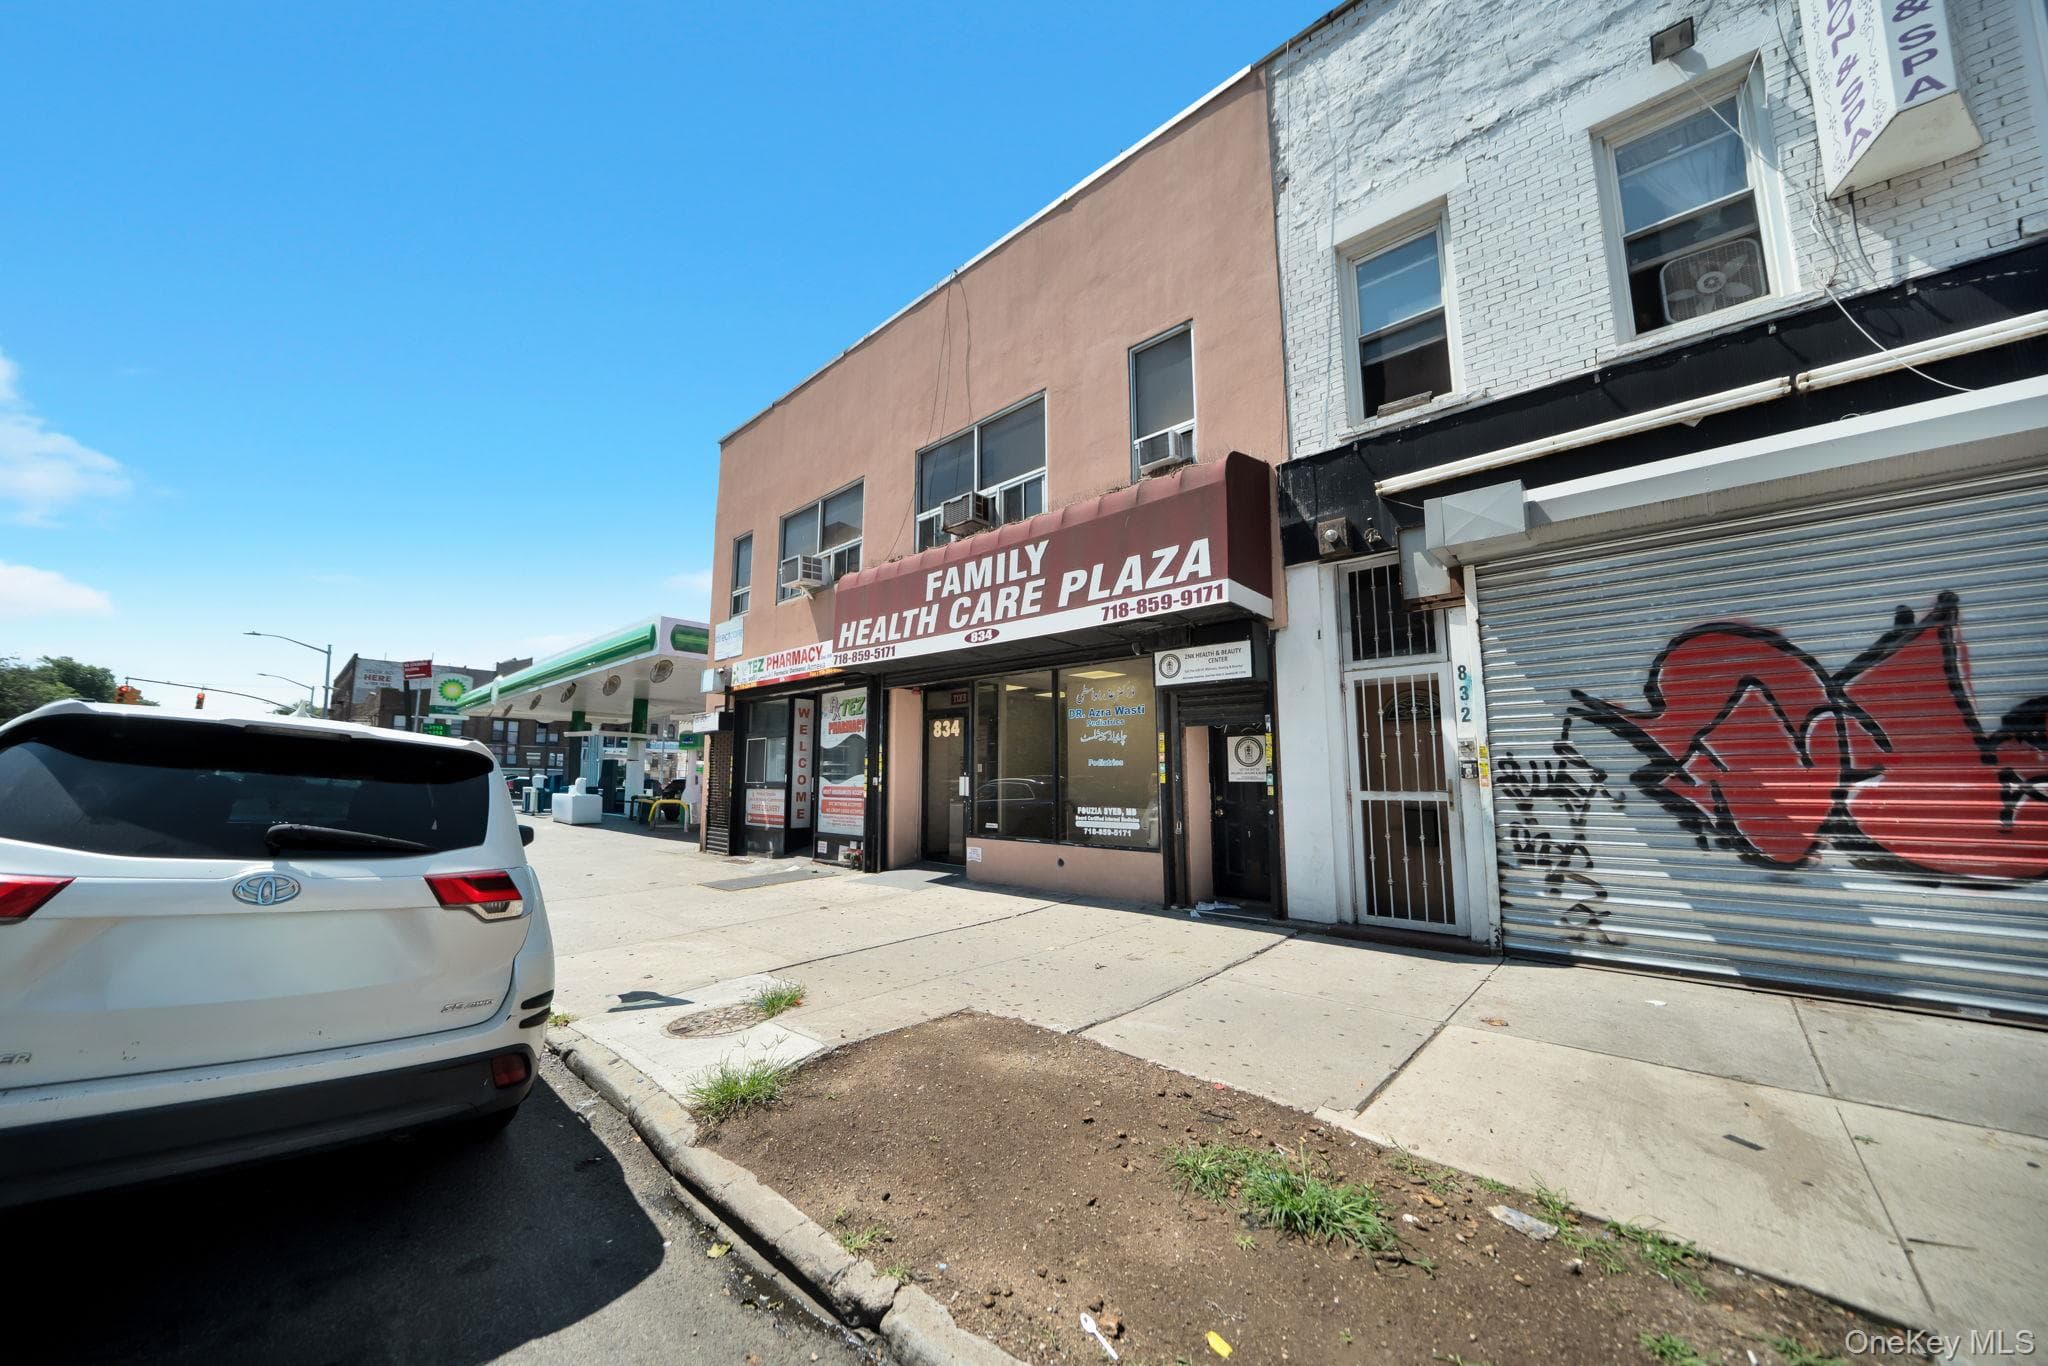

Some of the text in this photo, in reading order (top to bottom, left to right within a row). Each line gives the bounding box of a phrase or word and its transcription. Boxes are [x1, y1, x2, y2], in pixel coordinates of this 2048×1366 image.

[1836, 53, 1860, 88] &
[1898, 23, 1947, 104] SPA
[1841, 75, 1873, 162] SPA
[926, 539, 1050, 601] FAMILY
[838, 537, 1212, 649] HEALTH CARE PLAZA
[1101, 583, 1224, 622] 718-859-9171
[970, 628, 994, 644] 834
[766, 645, 823, 671] PHARMACY
[833, 645, 896, 666] 718-859-5171
[1195, 650, 1215, 659] HEALTH
[1221, 648, 1242, 656] BEAUTY
[1208, 656, 1228, 664] CENTER
[363, 674, 392, 682] HERE
[1457, 665, 1471, 722] 832
[840, 697, 866, 716] TEZ
[1068, 703, 1146, 720] DR. Azra Wasti
[828, 720, 866, 734] PHARMACY
[933, 720, 960, 737] 834
[796, 707, 810, 820] WELCOME
[1077, 806, 1103, 815] FOUZIA
